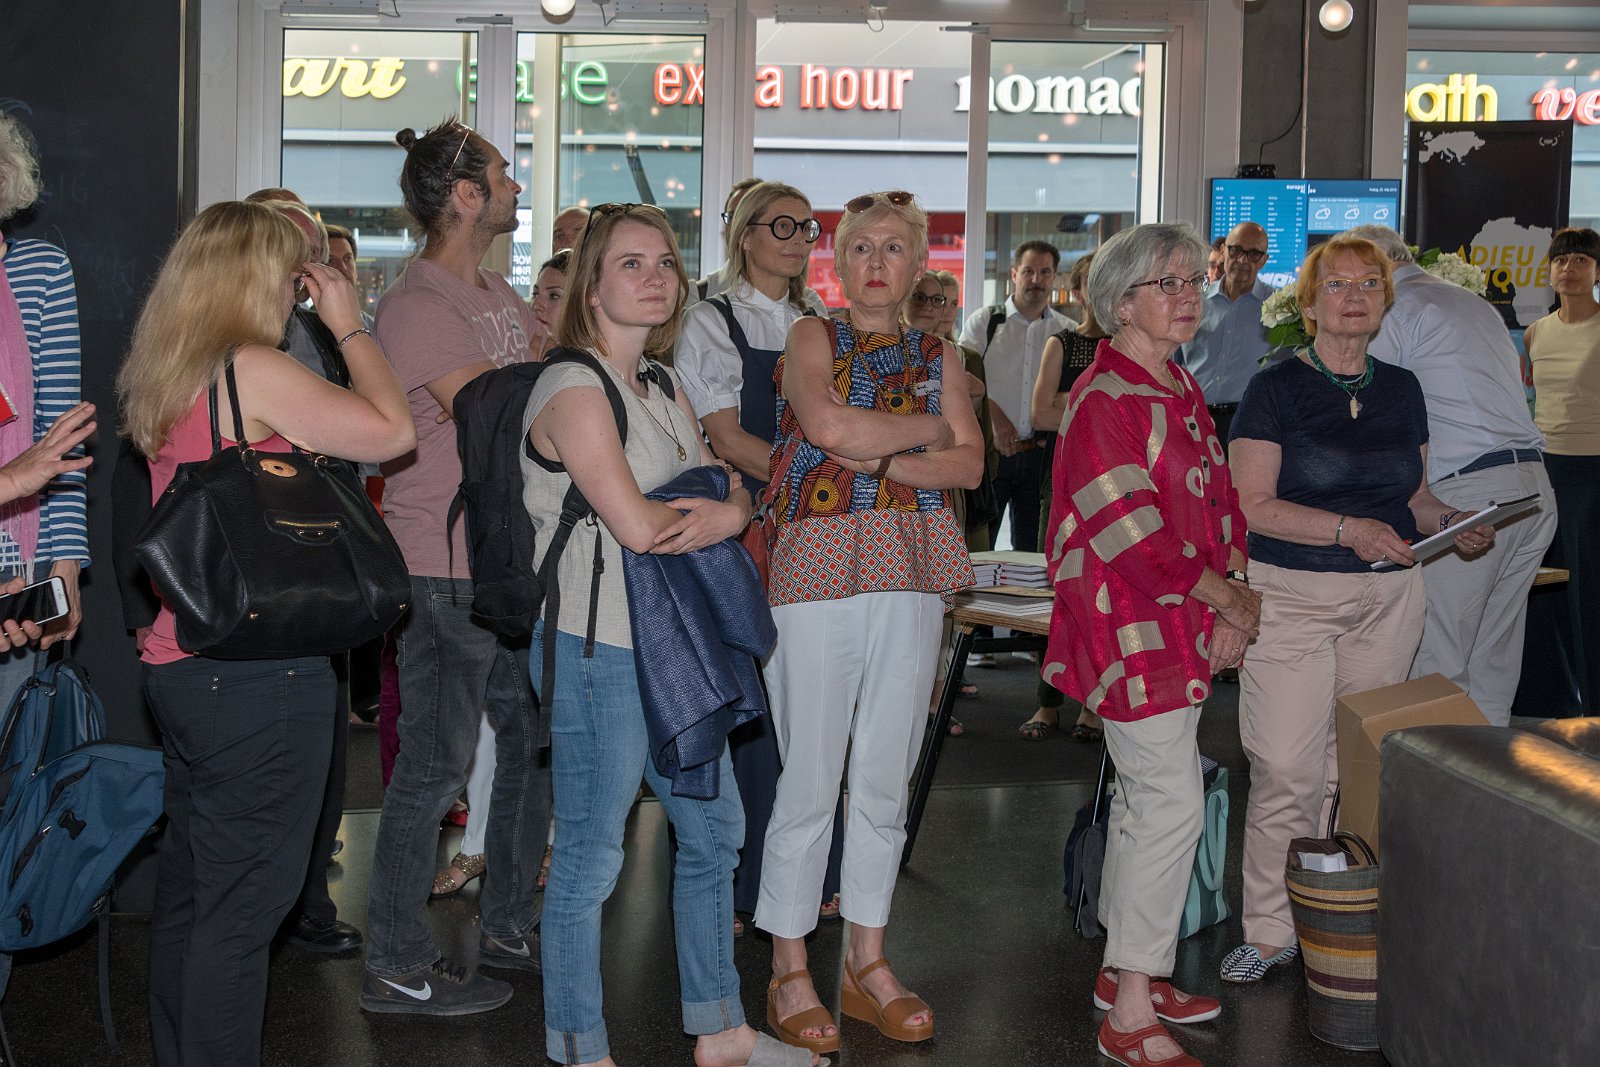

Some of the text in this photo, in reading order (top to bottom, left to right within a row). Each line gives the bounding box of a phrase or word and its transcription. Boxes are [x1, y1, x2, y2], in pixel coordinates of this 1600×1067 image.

[654, 63, 913, 110] exa hour
[1405, 73, 1498, 122] ath
[1457, 244, 1535, 267] ADIEU
[1484, 267, 1549, 294] IQUE
